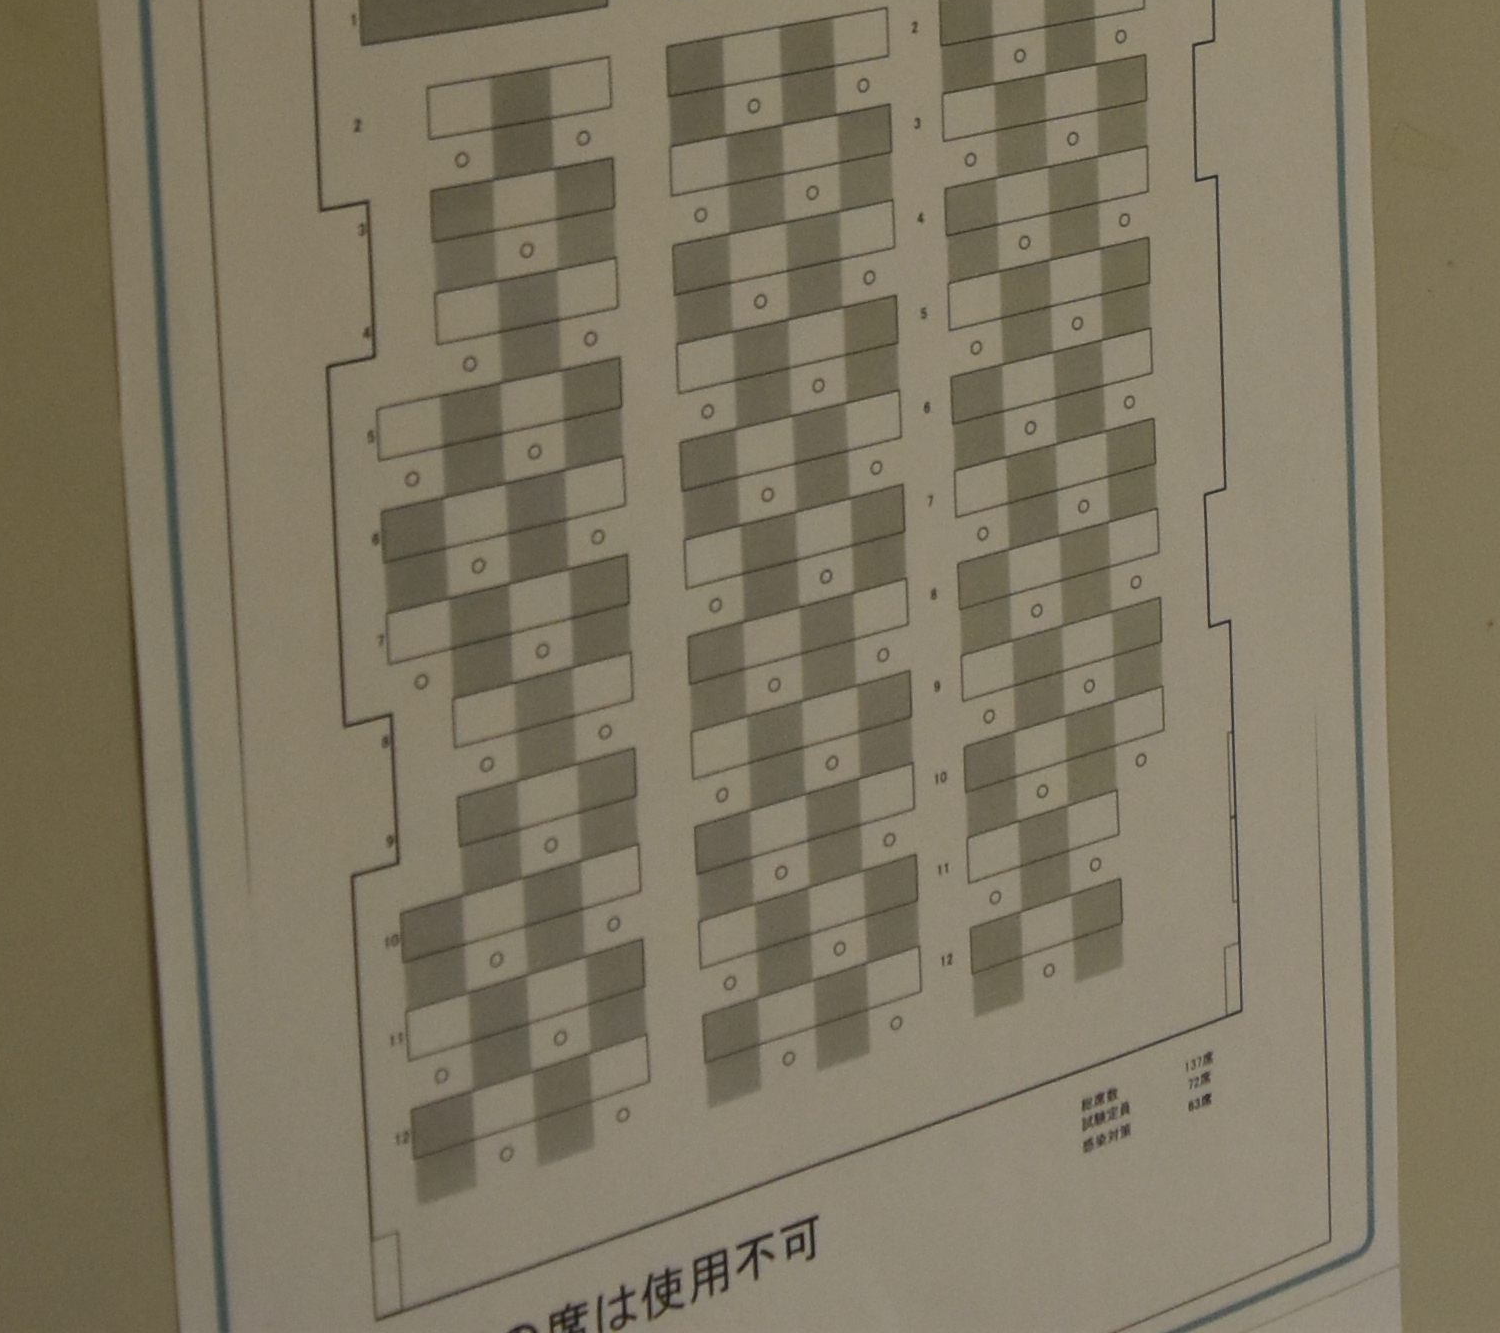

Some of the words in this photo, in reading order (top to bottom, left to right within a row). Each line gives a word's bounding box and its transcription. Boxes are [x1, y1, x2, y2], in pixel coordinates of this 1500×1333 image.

[506, 1214, 820, 1333] 席は使用不可
